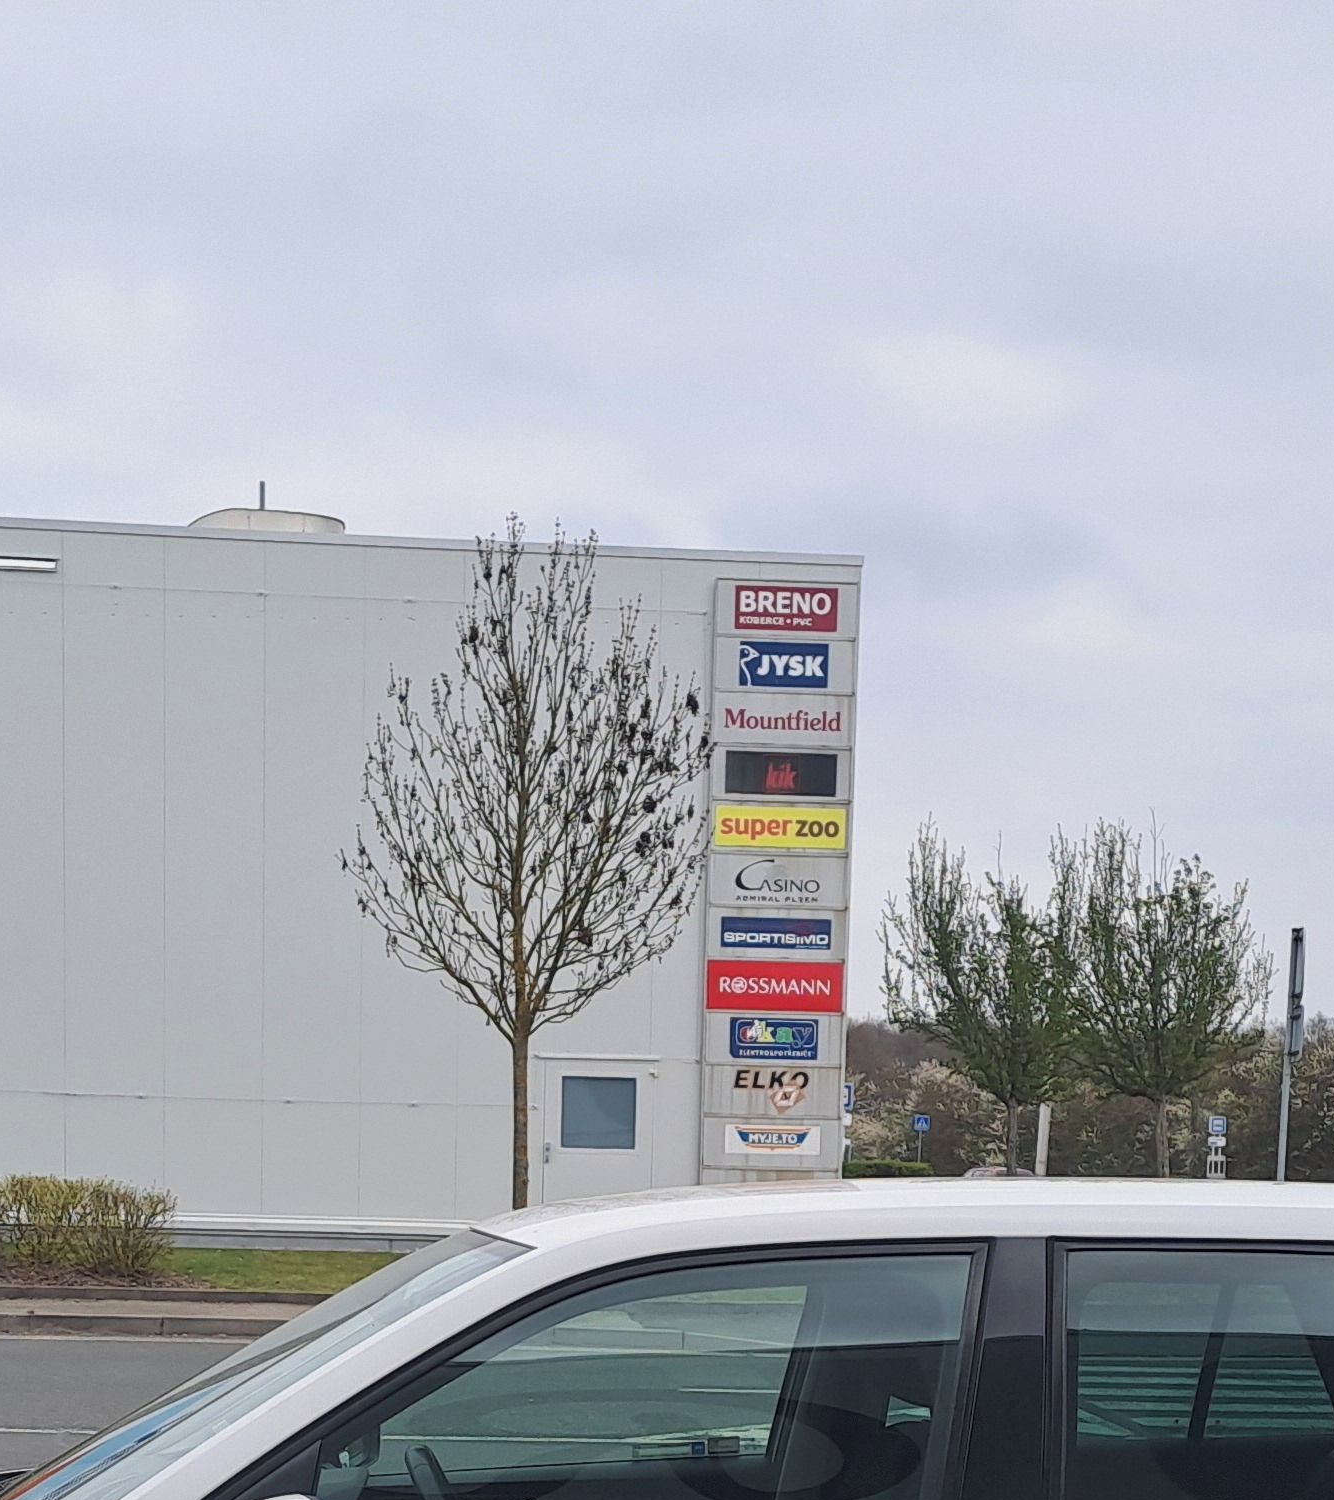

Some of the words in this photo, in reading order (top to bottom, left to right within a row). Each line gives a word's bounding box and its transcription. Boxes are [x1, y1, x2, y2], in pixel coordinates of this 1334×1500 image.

[739, 590, 832, 616] BRENO
[756, 654, 825, 677] JYSK
[723, 707, 842, 732] Mountfield
[719, 976, 832, 996] ROSSMANN
[733, 1069, 810, 1090] ELKO
